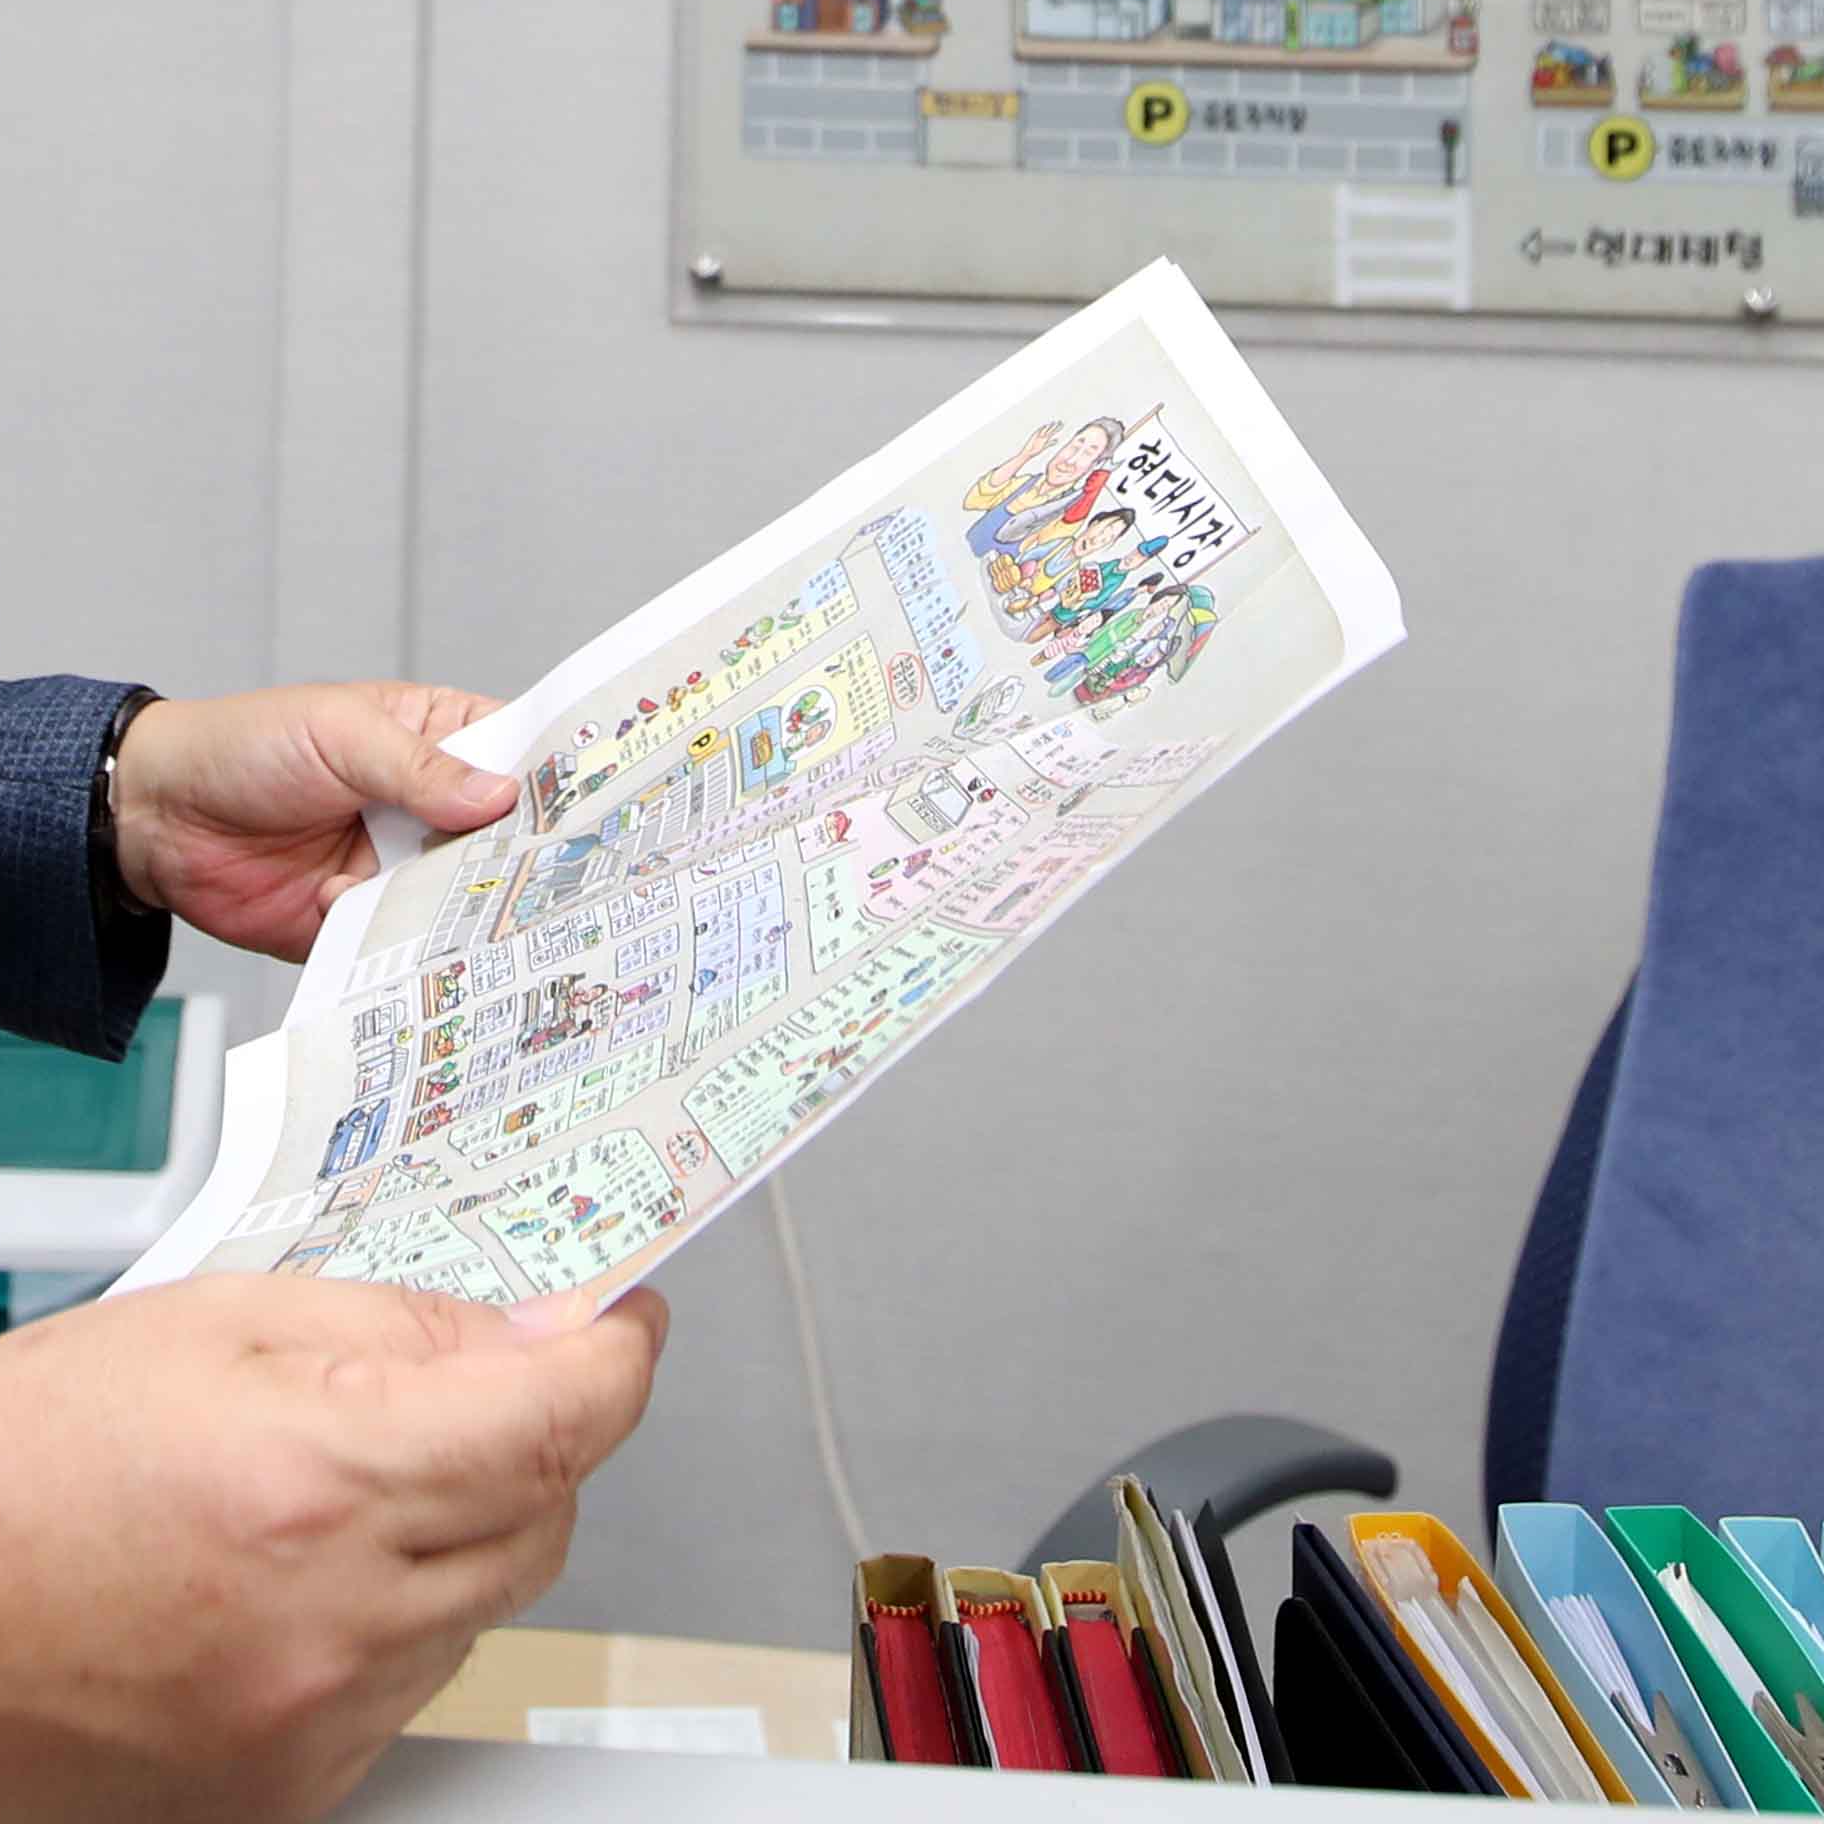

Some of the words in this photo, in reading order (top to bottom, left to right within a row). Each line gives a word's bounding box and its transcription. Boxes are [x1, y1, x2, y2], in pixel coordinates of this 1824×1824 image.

[1141, 97, 1175, 132] P
[1606, 130, 1638, 166] P
[1118, 438, 1236, 570] 현대시장
[691, 733, 711, 748] P
